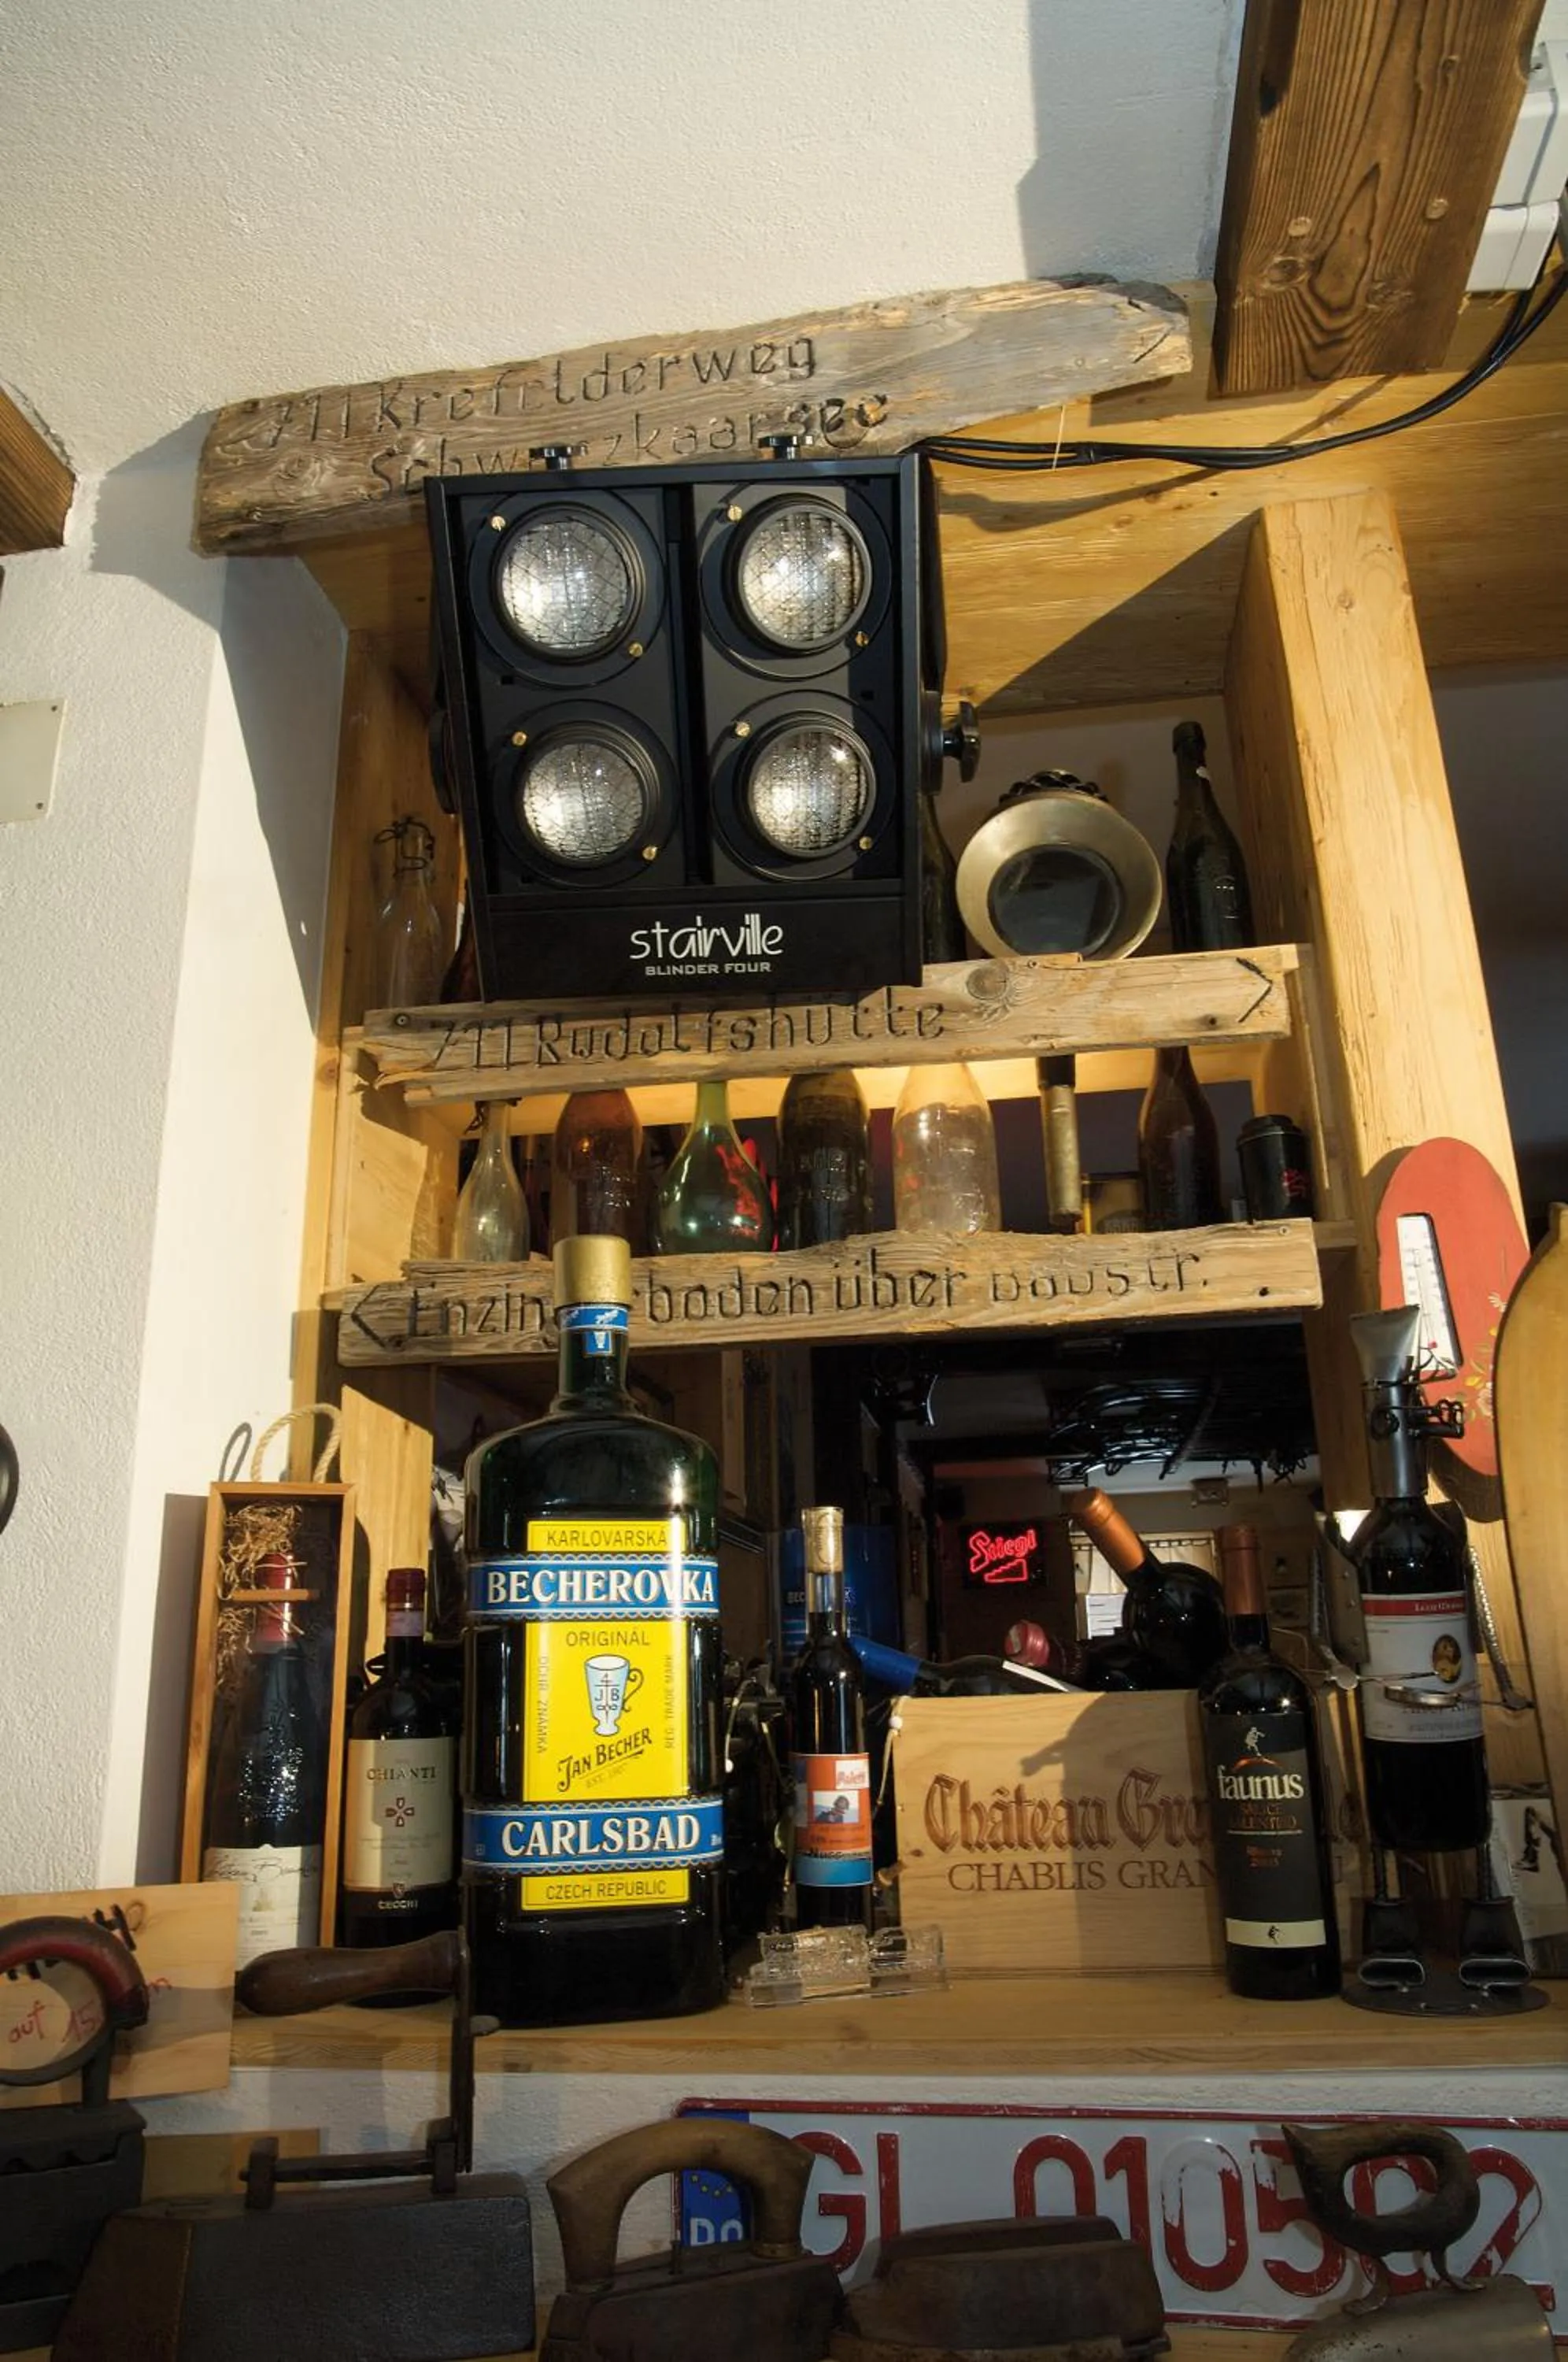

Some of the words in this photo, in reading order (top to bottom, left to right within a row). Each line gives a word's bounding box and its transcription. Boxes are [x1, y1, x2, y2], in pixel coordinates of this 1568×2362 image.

[376, 338, 816, 433] Krefelderweg
[631, 913, 783, 960] stairville
[645, 962, 719, 976] BLINDER
[724, 961, 771, 974] FOUR
[834, 1248, 967, 1310] über
[546, 1527, 668, 1548] KARLOVARSKÁ
[486, 1568, 715, 1605] BECHEROVKA
[566, 1627, 651, 1648] ORIGINÁL
[595, 1728, 653, 1766] BECHER
[366, 1766, 437, 1781] CHIANTI
[1217, 1764, 1304, 1800] faunus
[923, 1772, 1112, 1854] Château
[501, 1815, 701, 1857] CARLSBAD
[545, 1885, 592, 1901] CZECH
[597, 1879, 668, 1898] REPUBLIC
[948, 1860, 1107, 1891] CHABLIS
